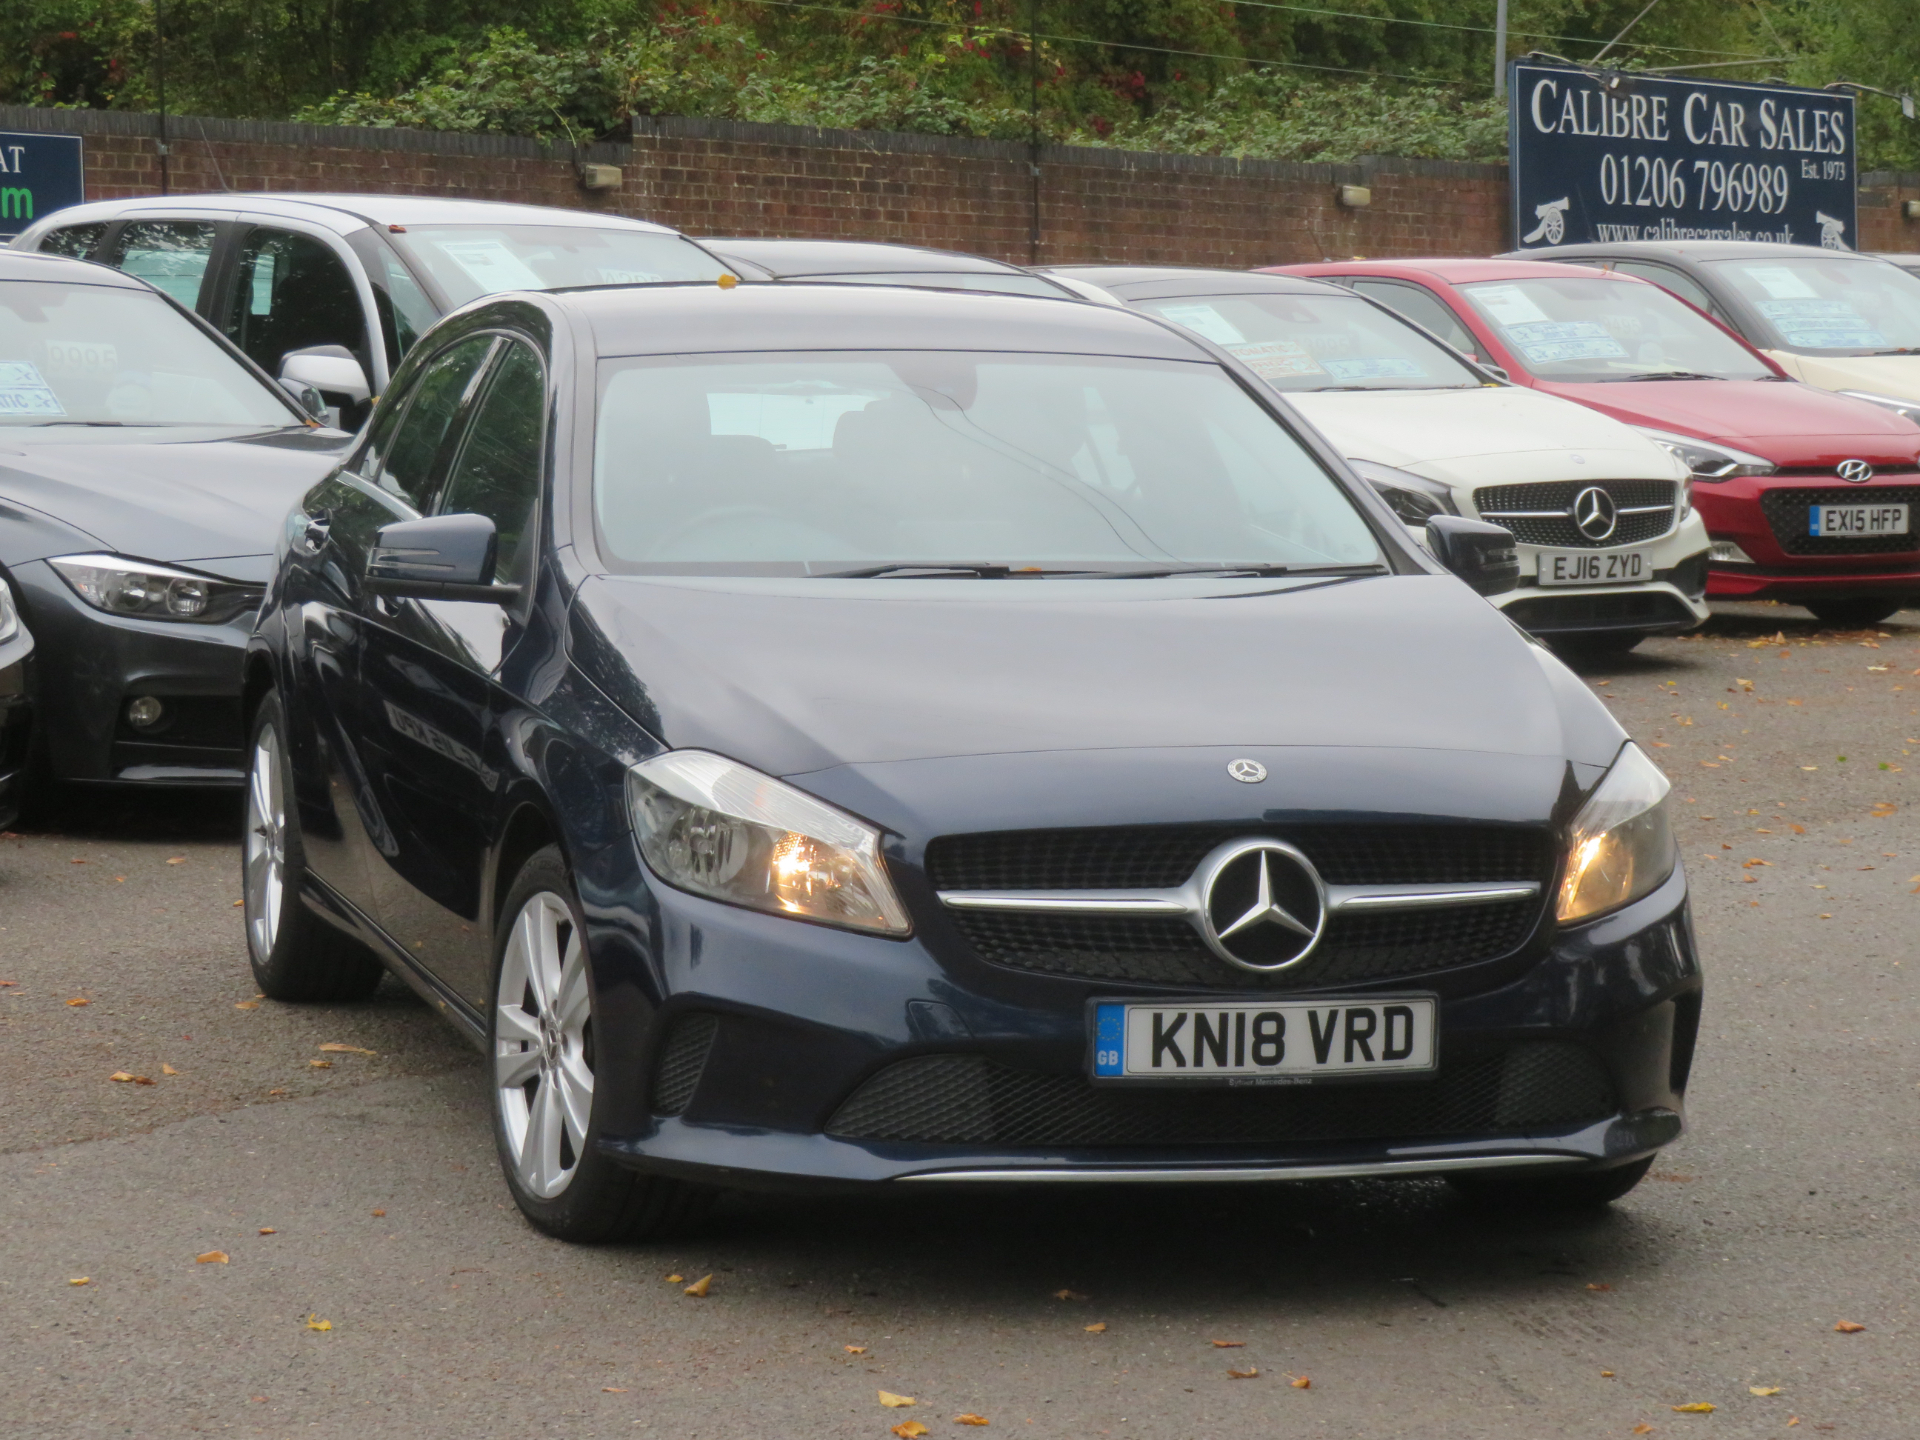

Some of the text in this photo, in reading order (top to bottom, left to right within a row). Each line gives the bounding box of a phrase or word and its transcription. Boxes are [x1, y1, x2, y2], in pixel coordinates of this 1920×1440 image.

[1531, 79, 1847, 155] CALIBRE CAR SALES
[1600, 153, 1789, 214] 01206 796989
[1801, 159, 1847, 181] Est. 1973
[1596, 217, 1795, 244] wwwcalibrecarsalescouk
[1826, 508, 1902, 531] EX15 HFP
[1554, 553, 1642, 581] EJ16 ZYD
[1151, 1005, 1414, 1068] KN18 VRD
[1097, 1050, 1119, 1066] GB
